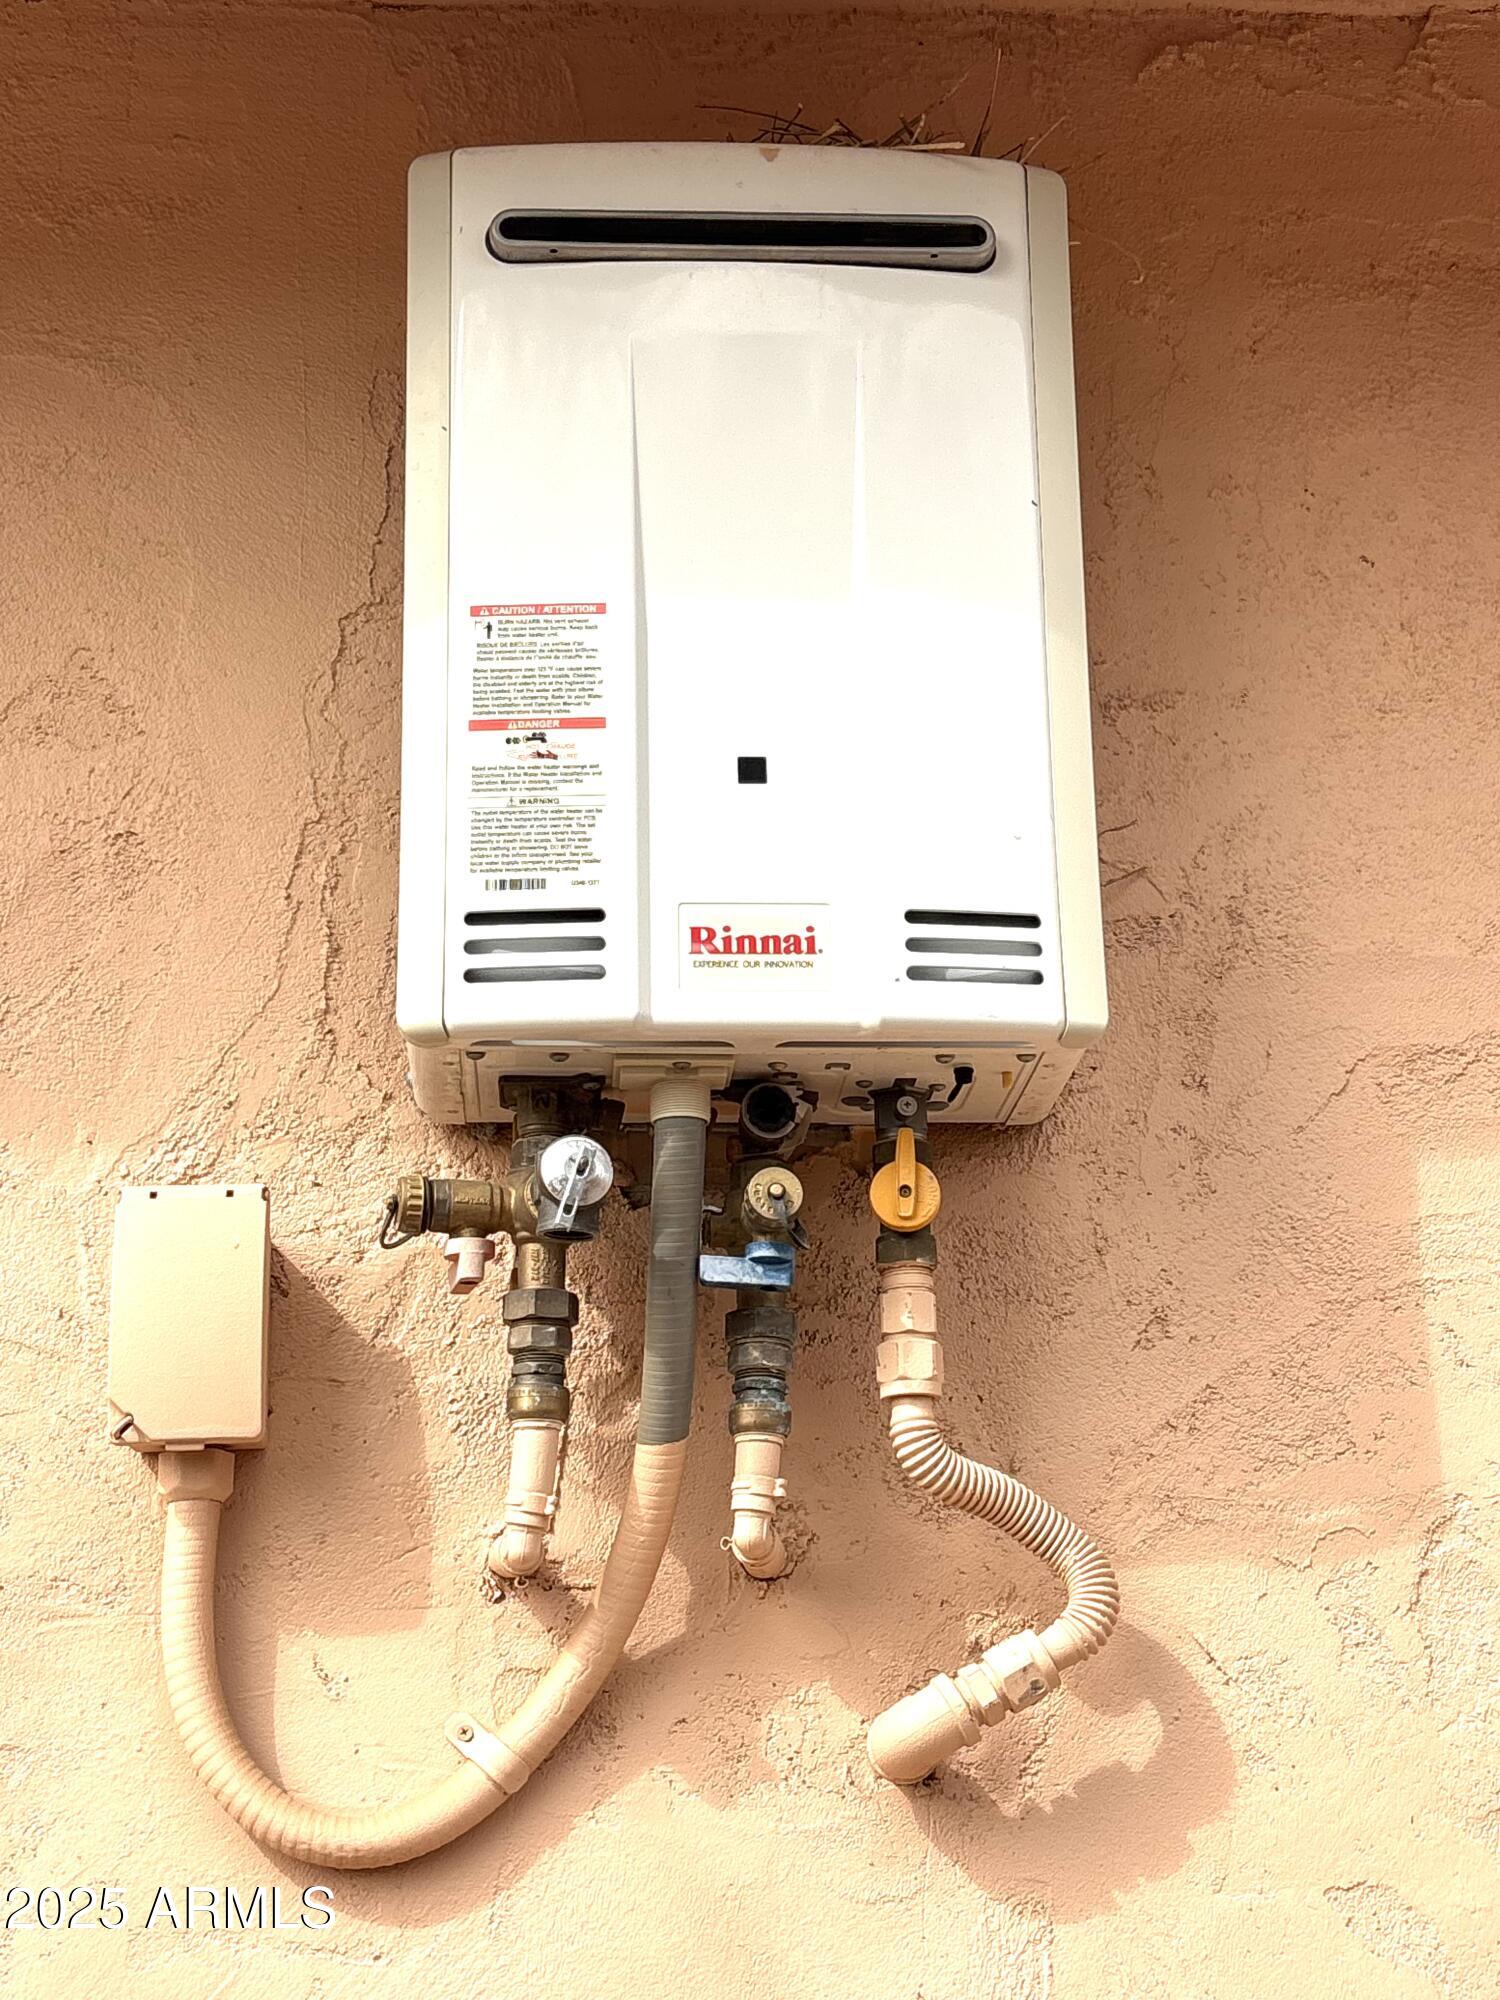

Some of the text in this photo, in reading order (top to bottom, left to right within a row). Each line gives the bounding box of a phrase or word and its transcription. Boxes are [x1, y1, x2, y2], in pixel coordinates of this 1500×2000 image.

[492, 605, 536, 615] CAUTION
[543, 604, 596, 614] ATTENTION
[518, 720, 560, 728] DANGER
[693, 960, 814, 968] EXPERIENCE OUR INNOVATION
